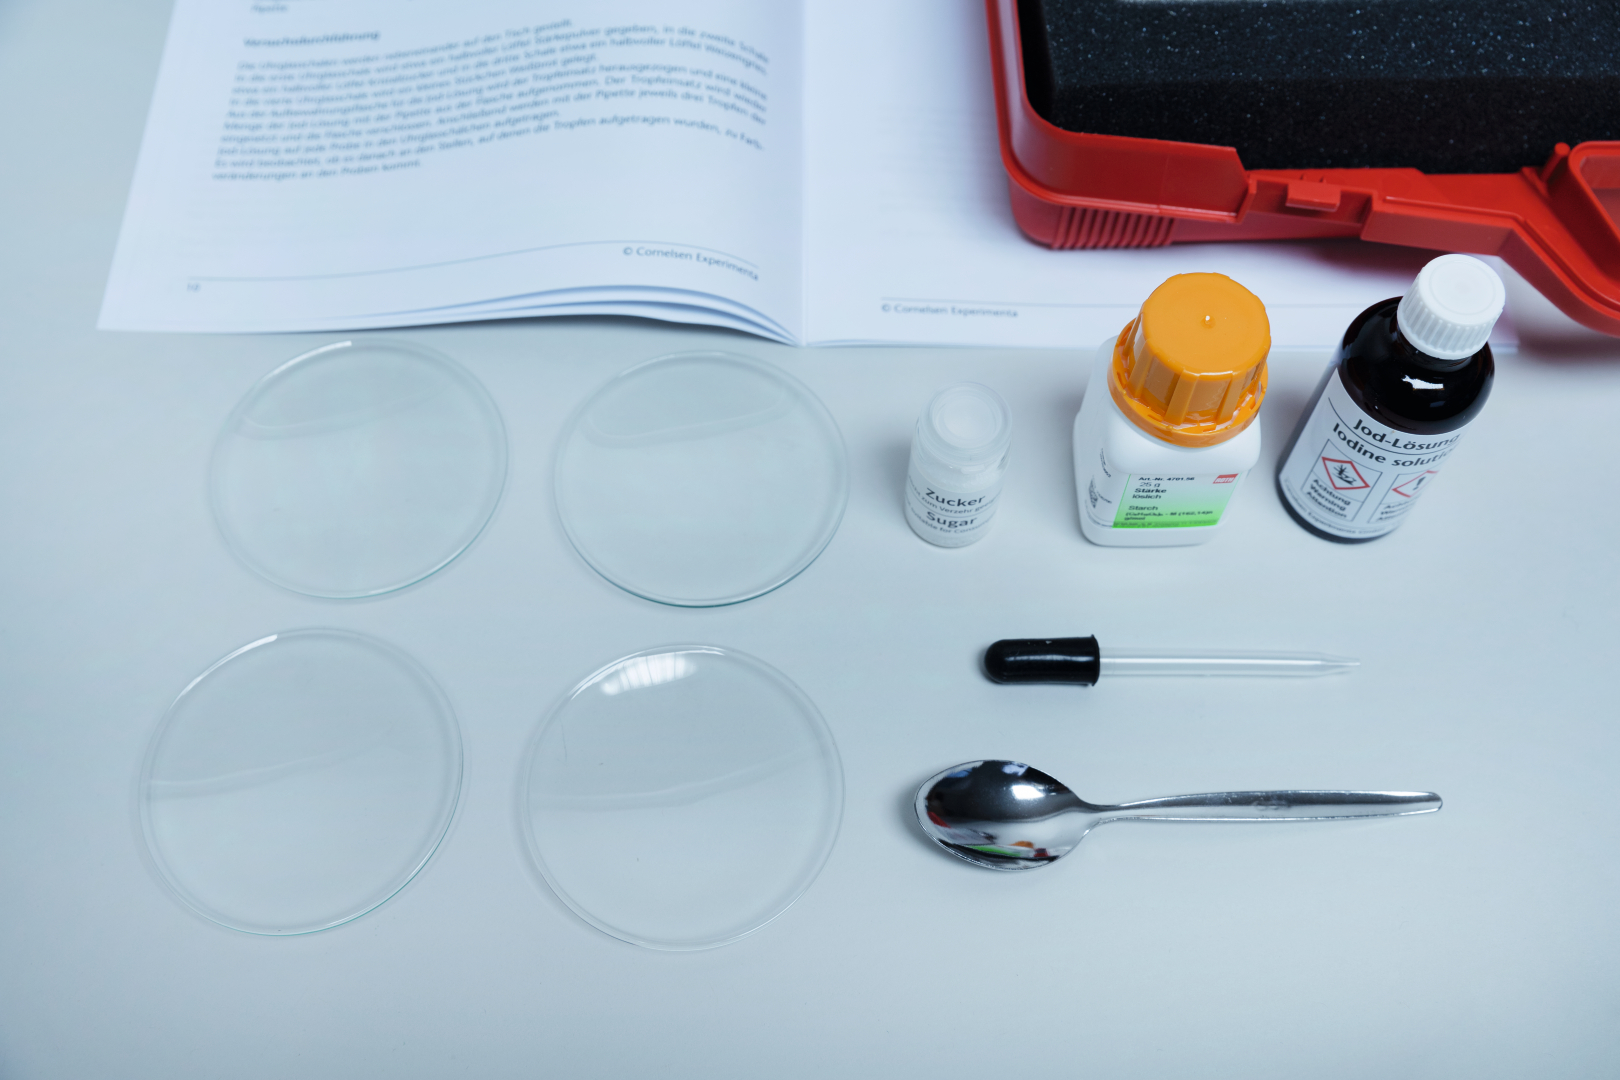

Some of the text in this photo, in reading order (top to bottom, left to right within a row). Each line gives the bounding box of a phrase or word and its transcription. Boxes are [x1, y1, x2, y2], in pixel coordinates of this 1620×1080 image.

[636, 246, 693, 261] Cornelsen
[696, 252, 759, 281] Experimenta
[894, 303, 948, 314] Cornelsen
[951, 306, 1018, 318] Experimenta
[1332, 422, 1387, 464] Iodine
[1353, 418, 1461, 451] Jod-Lösung
[926, 487, 986, 507] Zucker
[1306, 490, 1348, 519] Attention
[1309, 483, 1347, 512] Warning
[1313, 478, 1352, 507] Achtung
[926, 511, 978, 529] Sugar
[939, 506, 974, 514] Verzehr
[939, 526, 952, 534] for
